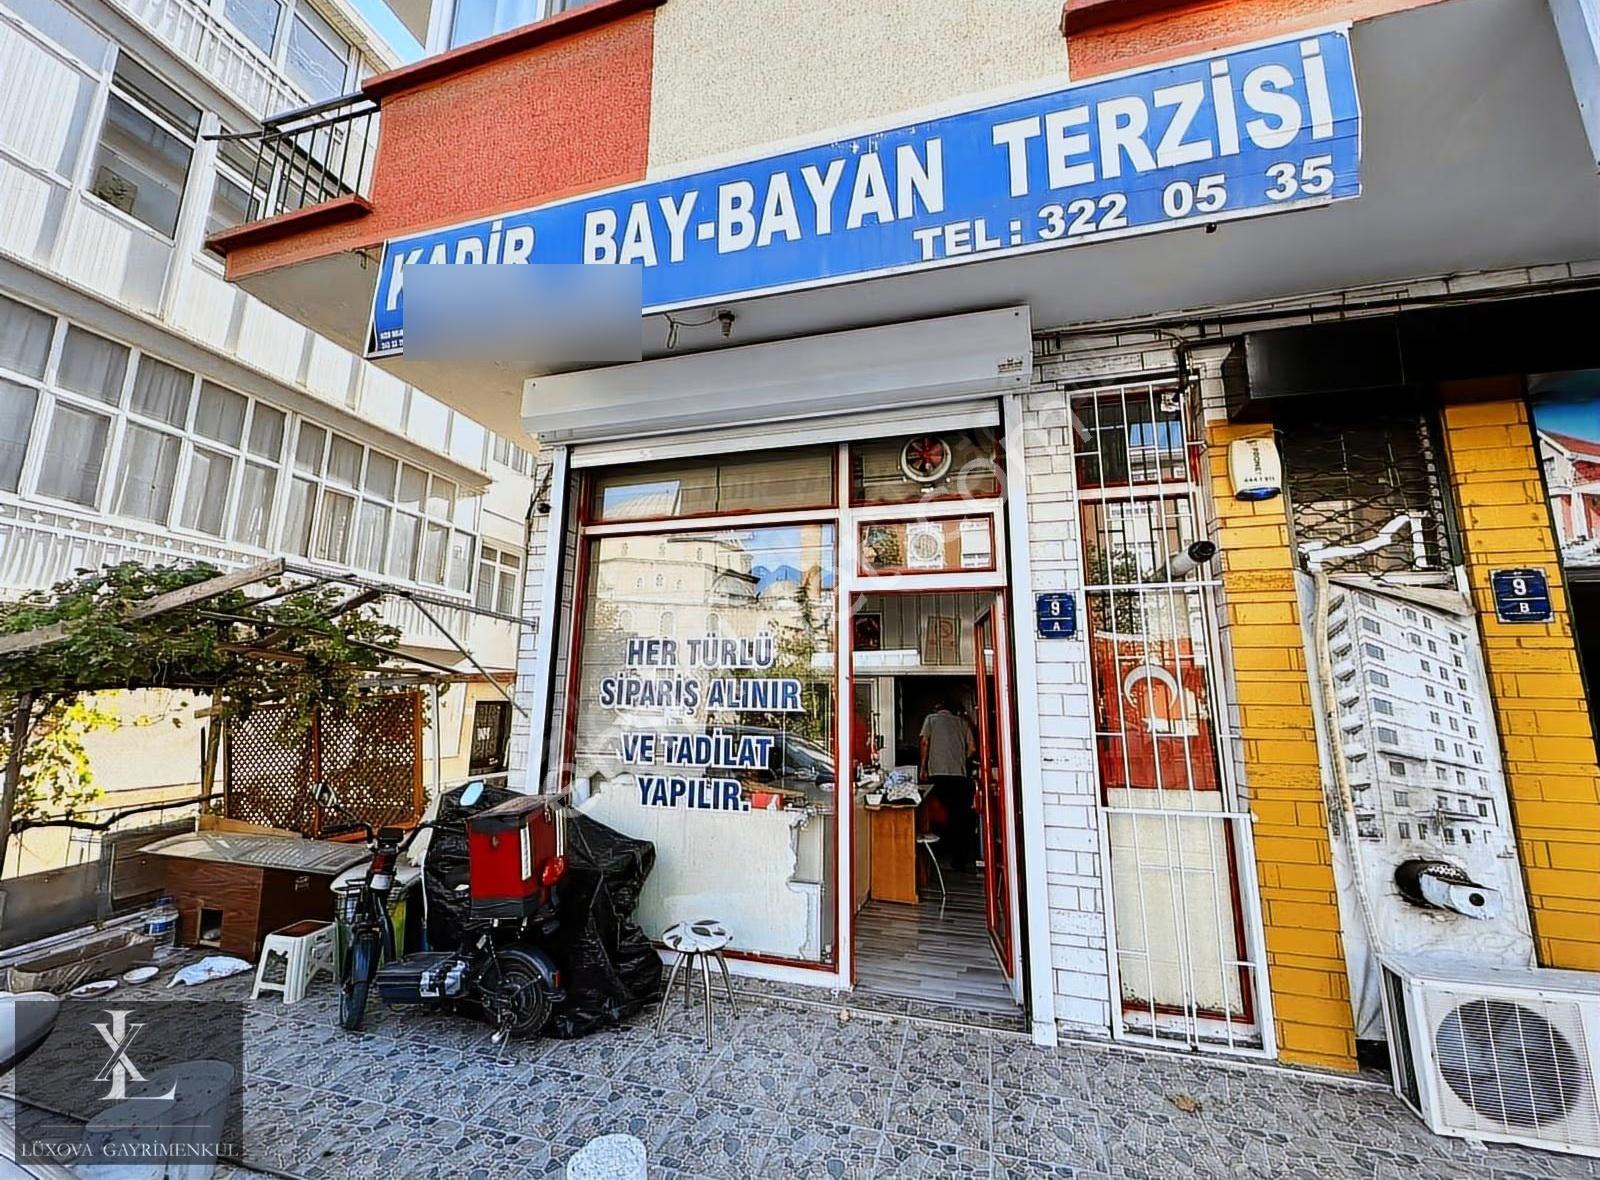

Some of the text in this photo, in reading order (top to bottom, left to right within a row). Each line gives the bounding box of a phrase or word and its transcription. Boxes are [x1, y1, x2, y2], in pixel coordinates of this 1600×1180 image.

[584, 138, 945, 267] BAY-BAYAN
[993, 38, 1334, 198] TERZİSİ
[1038, 193, 1128, 240] 322
[1163, 174, 1227, 218] 05
[1264, 155, 1334, 200] 35
[1512, 578, 1527, 596] 9
[1051, 601, 1060, 616] 9
[1519, 602, 1530, 613] B
[1052, 621, 1061, 631] A
[627, 632, 773, 667] HER TÜRLÜ
[601, 672, 800, 715] SİPARİŞ ALINIR
[622, 727, 773, 767] VE TADİLAT
[638, 777, 750, 811] YAPILIR.
